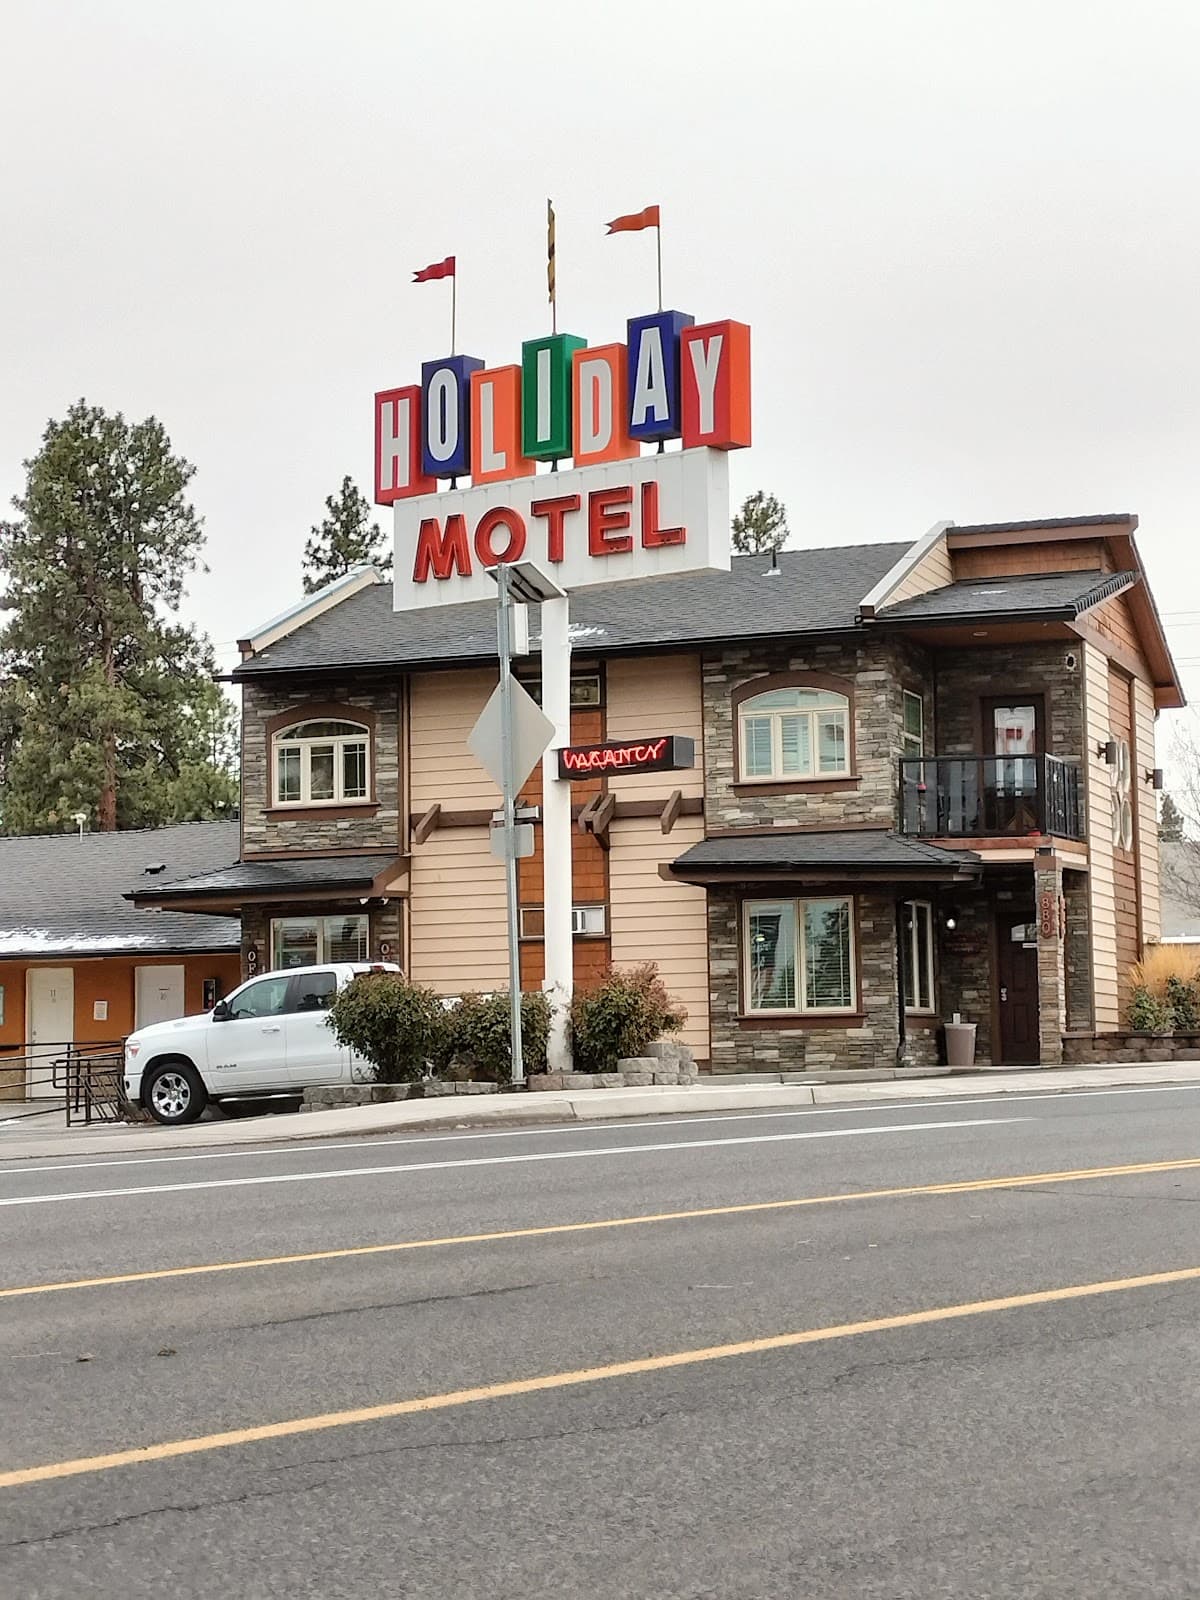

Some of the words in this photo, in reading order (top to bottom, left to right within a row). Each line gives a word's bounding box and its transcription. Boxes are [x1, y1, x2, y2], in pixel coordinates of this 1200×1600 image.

[380, 326, 724, 491] HOLIDAY
[412, 481, 686, 583] MOTEL
[1041, 897, 1051, 934] 880
